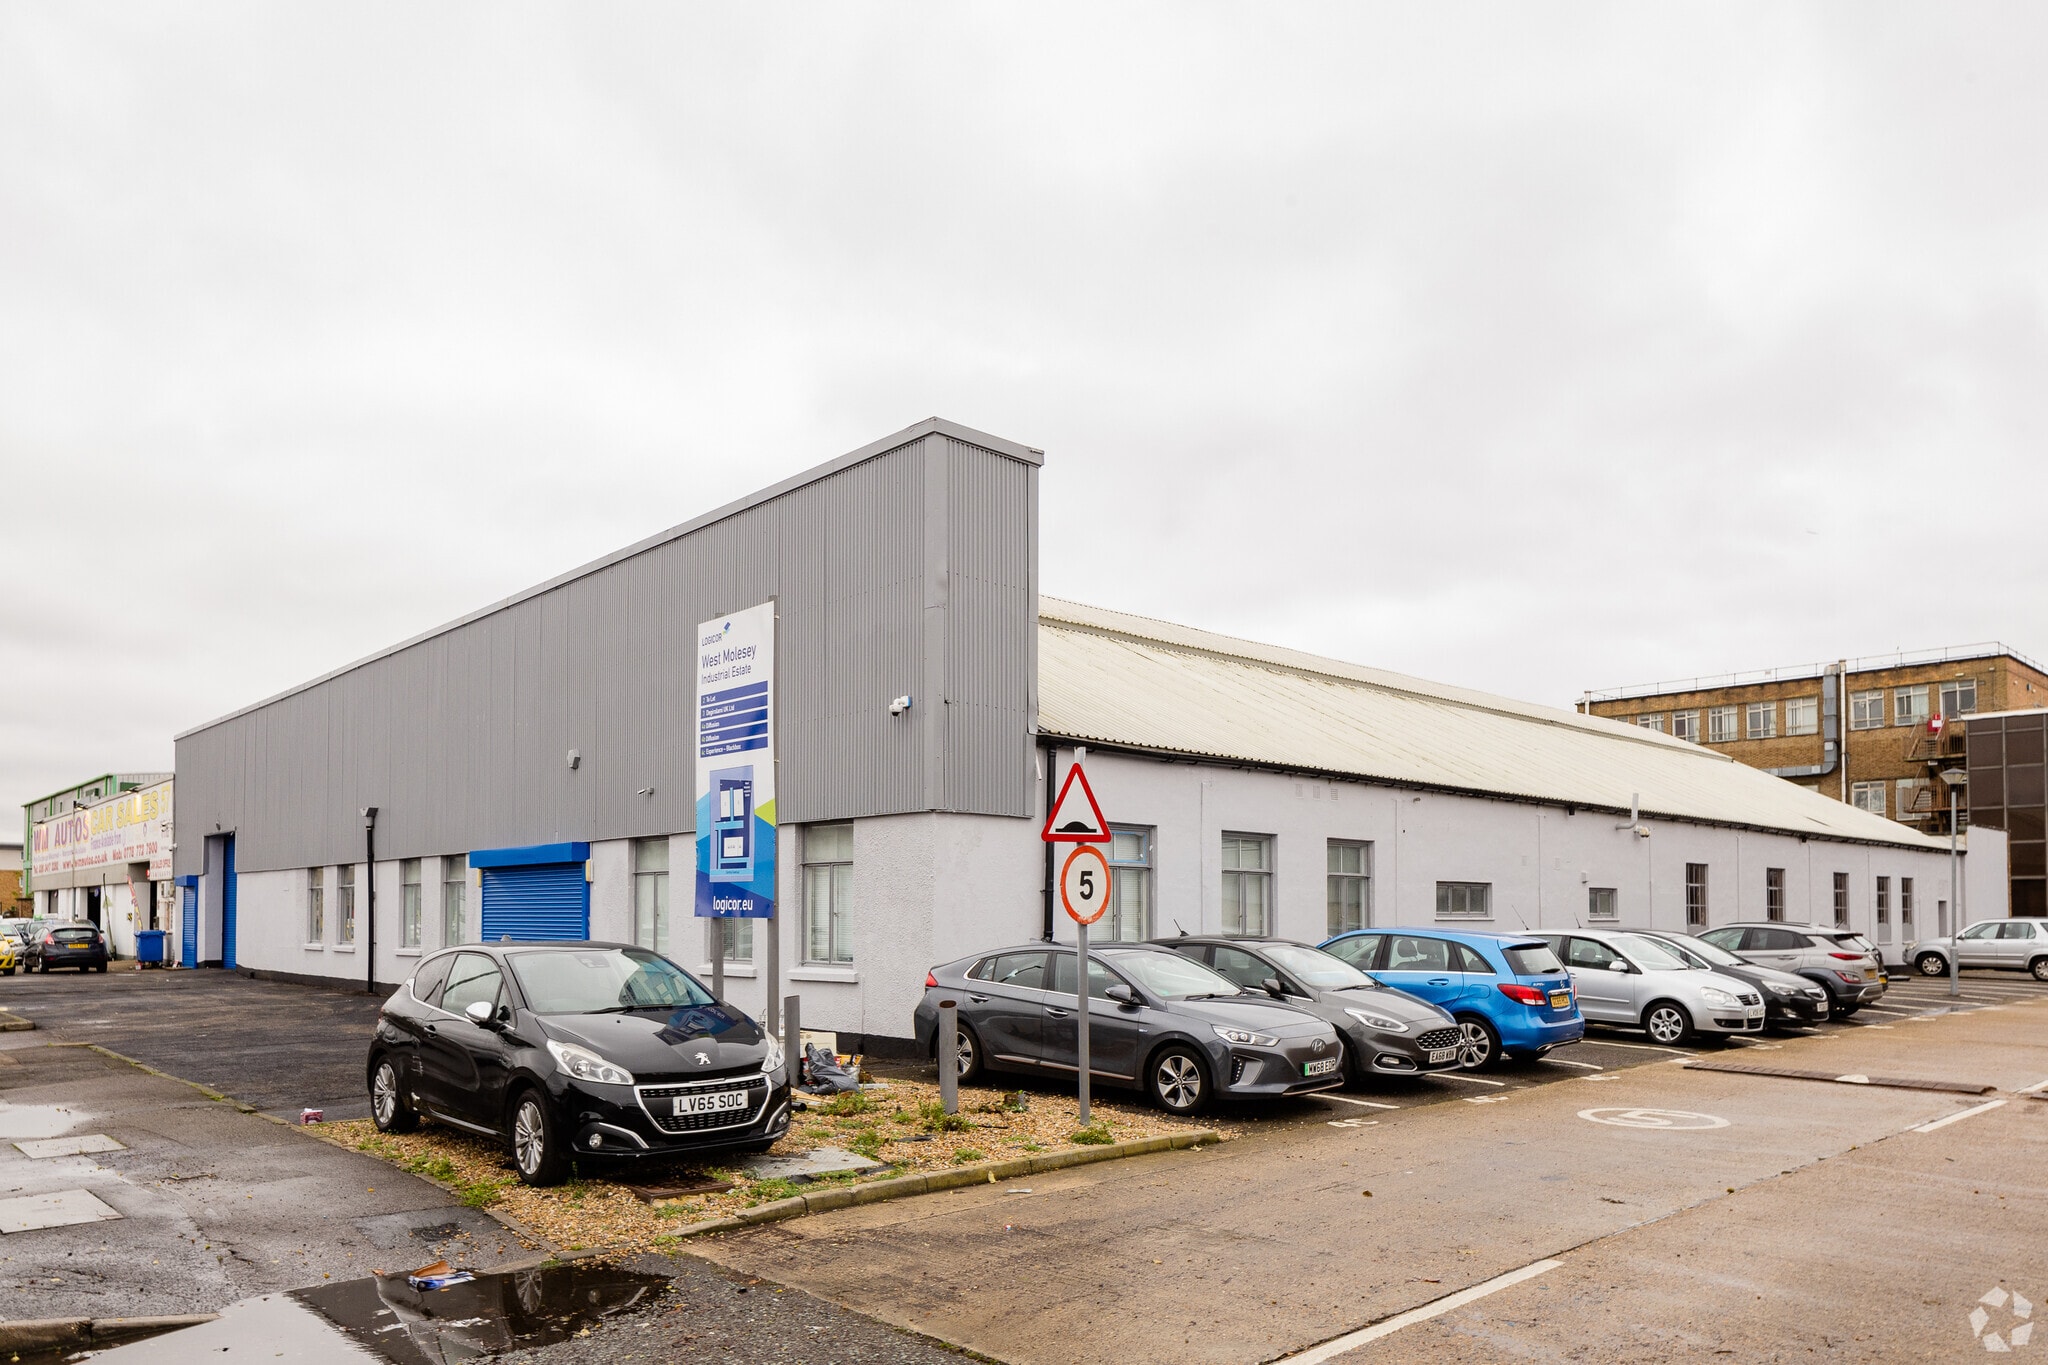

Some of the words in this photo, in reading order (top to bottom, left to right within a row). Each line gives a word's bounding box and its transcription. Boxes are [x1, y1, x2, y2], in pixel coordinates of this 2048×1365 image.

[701, 633, 723, 647] LOGICOR
[701, 653, 721, 669] West
[722, 644, 757, 663] Molesey
[701, 667, 731, 685] Industrial
[732, 664, 752, 678] Estate
[34, 827, 49, 852] WM
[55, 814, 89, 848] AUTOS
[91, 805, 114, 835] CAR
[116, 790, 159, 829] SALES
[1079, 870, 1094, 901] 5
[712, 896, 753, 914] logicor.eu
[679, 1096, 715, 1113] LV65
[718, 1093, 743, 1108] SOC
